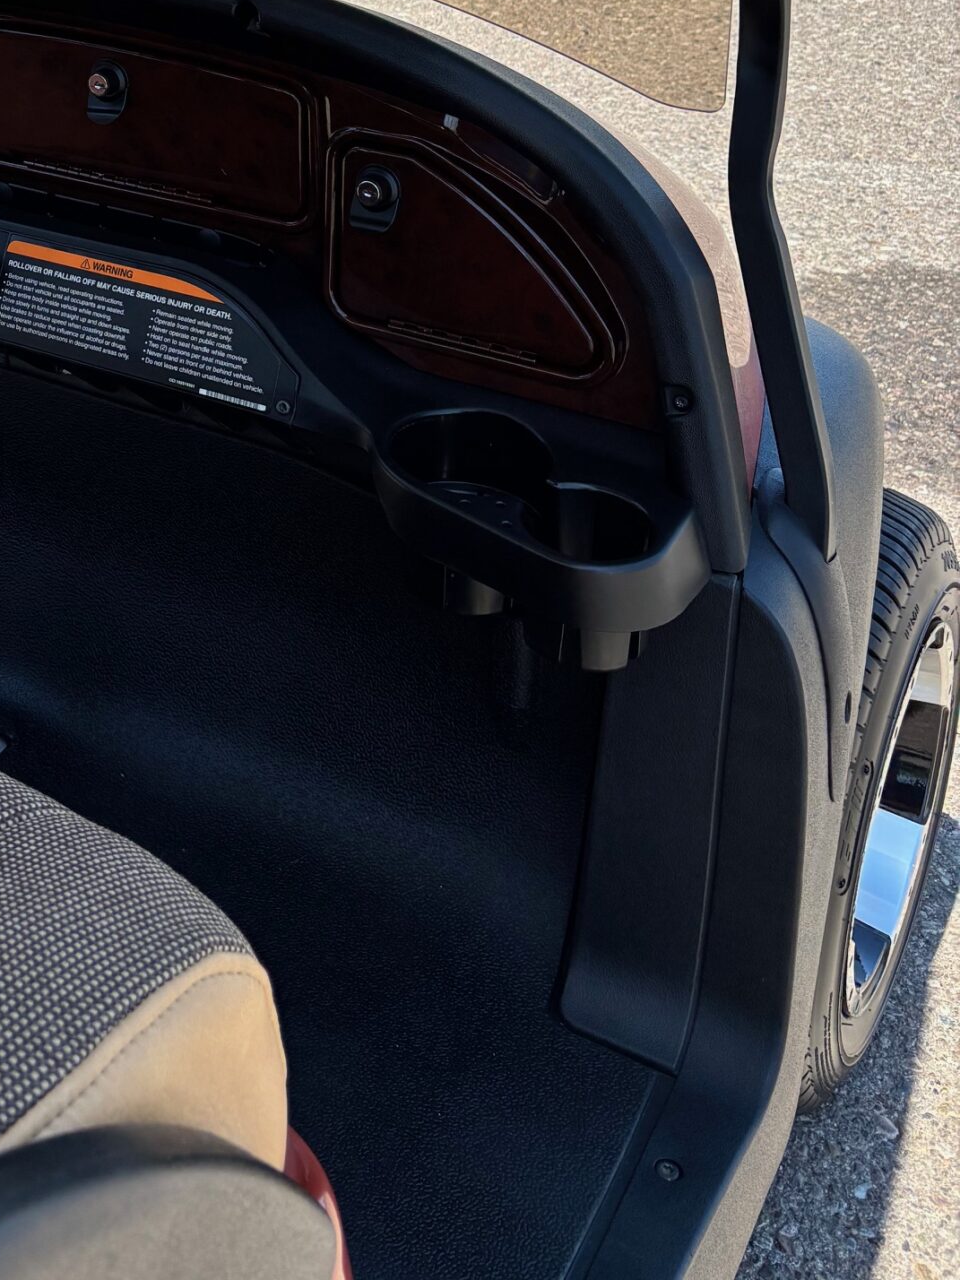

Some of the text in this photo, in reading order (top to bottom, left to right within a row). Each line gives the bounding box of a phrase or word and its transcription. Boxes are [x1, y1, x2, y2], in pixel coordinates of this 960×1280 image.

[92, 261, 133, 279] WARNING
[8, 260, 232, 320] ROLLOVER OR FALLING OFF MAY CAUSE SERIOUS INJURY OR DEATH.
